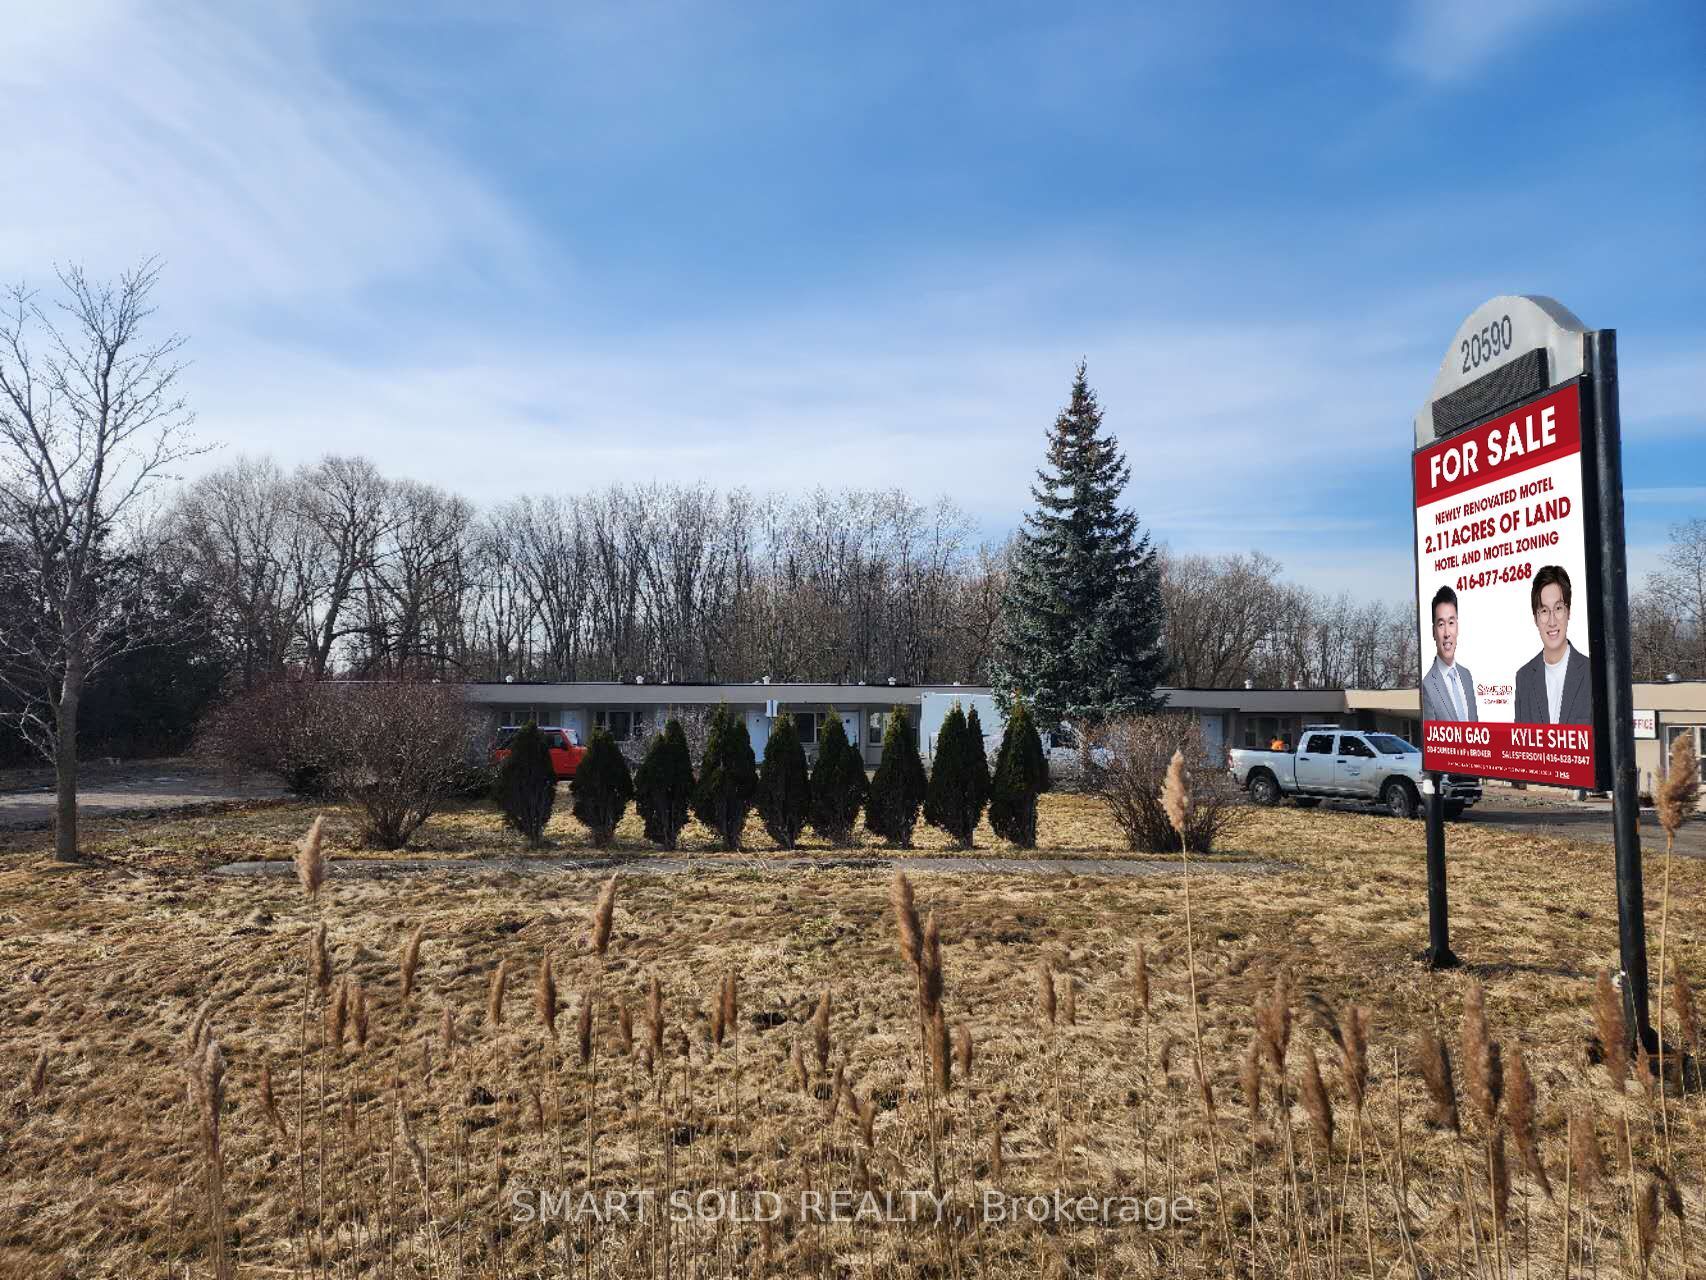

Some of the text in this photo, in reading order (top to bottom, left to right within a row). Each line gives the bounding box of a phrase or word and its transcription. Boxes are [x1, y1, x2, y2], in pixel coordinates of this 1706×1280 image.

[1461, 315, 1512, 374] 20590
[1430, 405, 1556, 489] FOR SALE
[1435, 477, 1553, 525] NEWLY RENOVATED MOTEL
[1500, 510, 1520, 534] OF
[1525, 496, 1571, 528] LAND
[1434, 531, 1559, 571] HOTEL AND MOTEL ZONING
[1456, 562, 1532, 591] 416-877-6268
[1427, 725, 1490, 745] JASON GAO
[1511, 728, 1589, 750] KYLE SHEN
